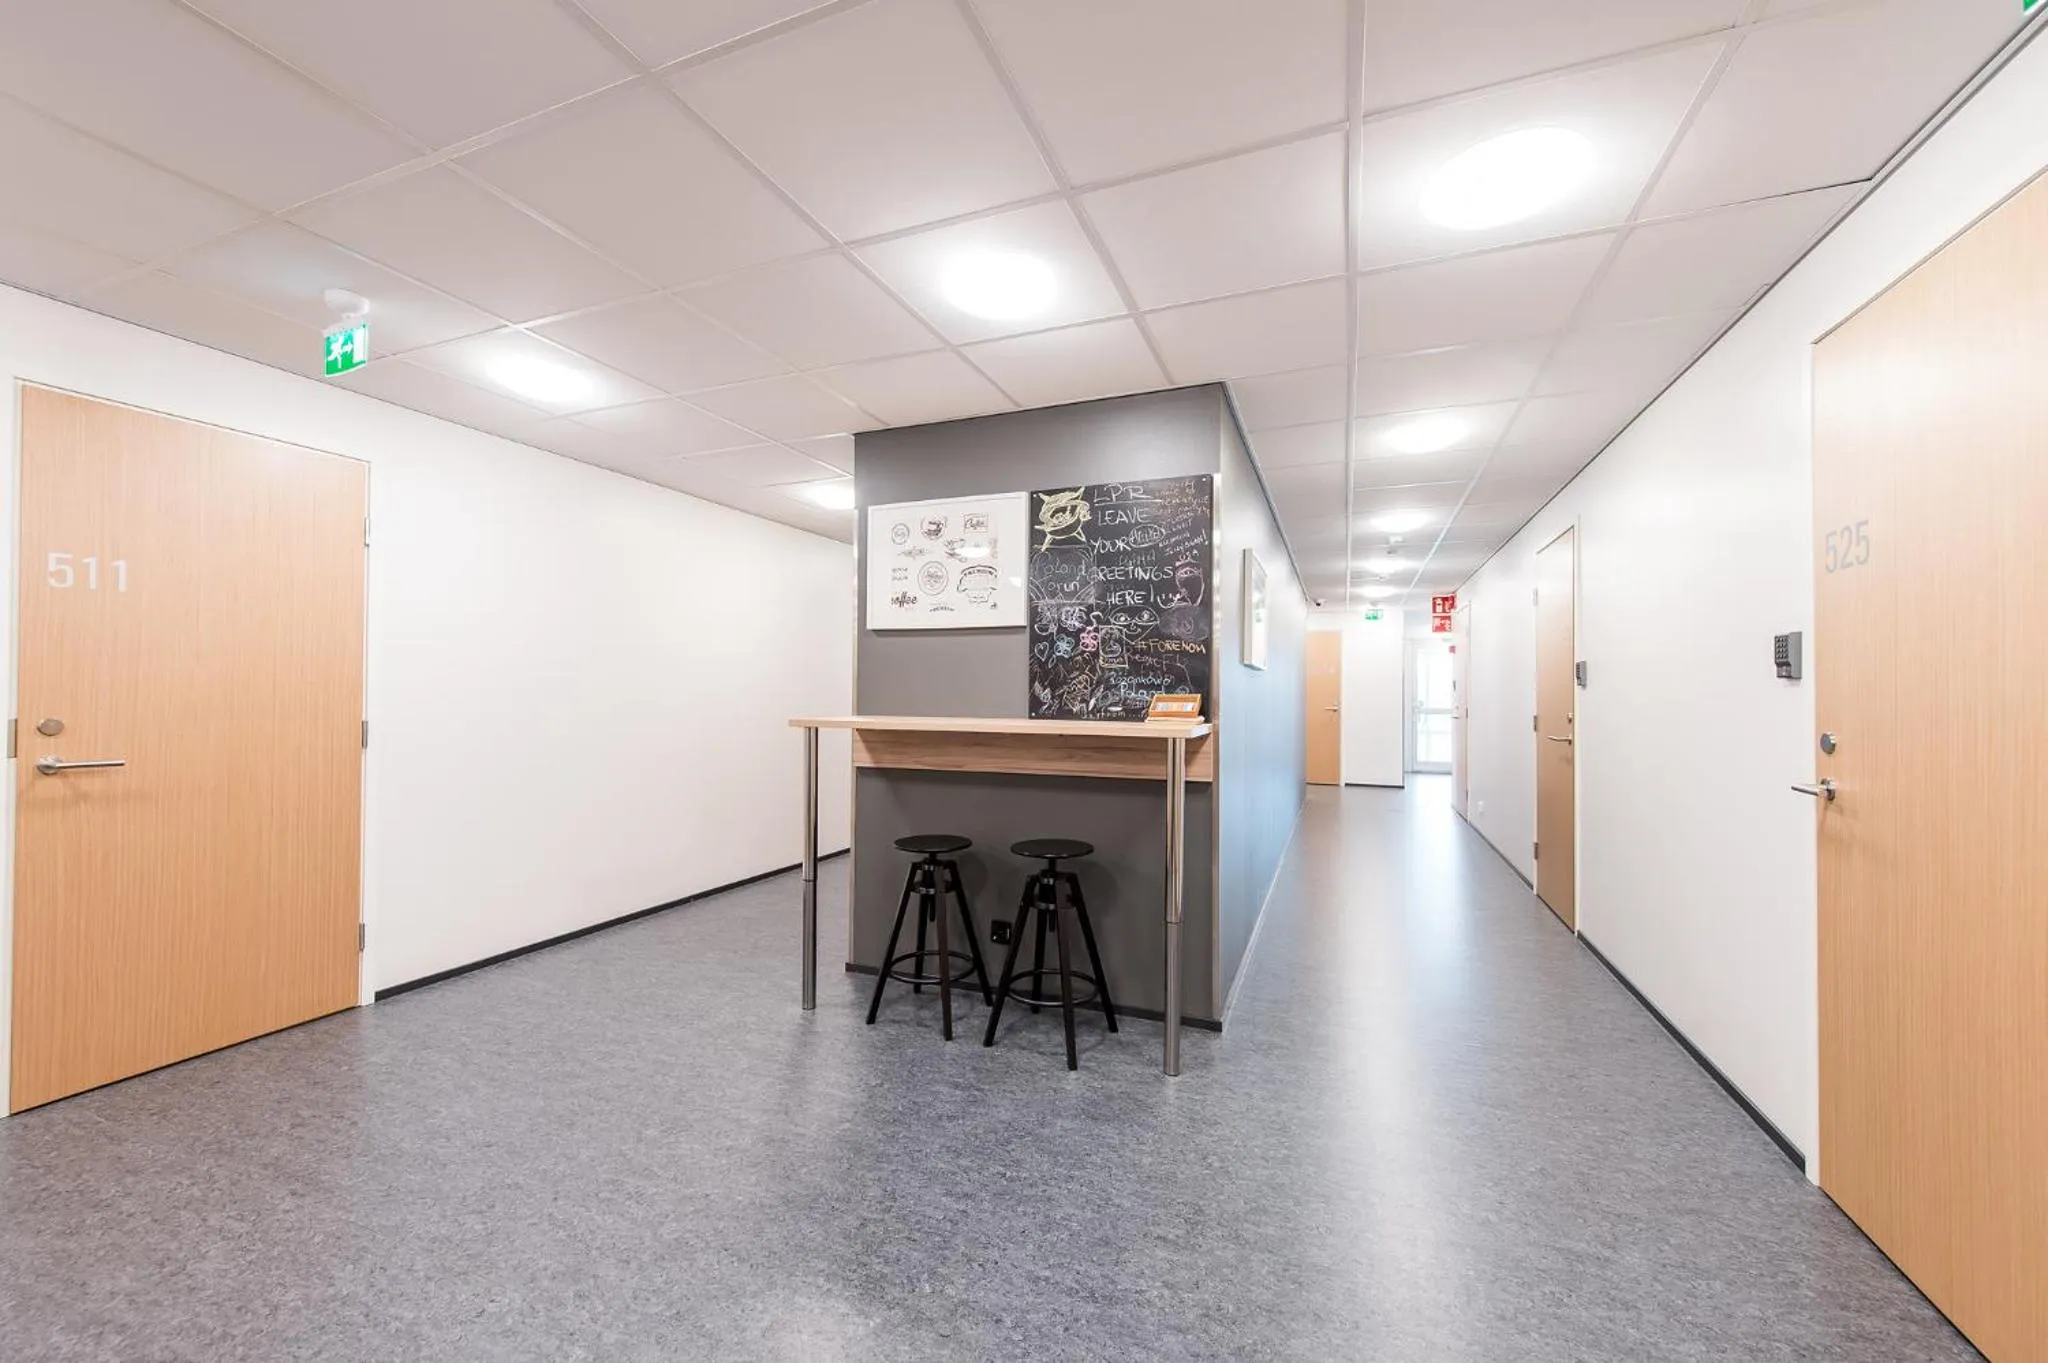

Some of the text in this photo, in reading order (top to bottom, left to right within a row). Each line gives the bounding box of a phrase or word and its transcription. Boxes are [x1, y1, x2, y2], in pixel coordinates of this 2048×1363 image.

[1098, 506, 1151, 526] LEAVE
[1090, 536, 1132, 554] YOUR
[1825, 520, 1870, 573] 525
[47, 552, 127, 593] 511
[1087, 565, 1174, 583] GREETINGS
